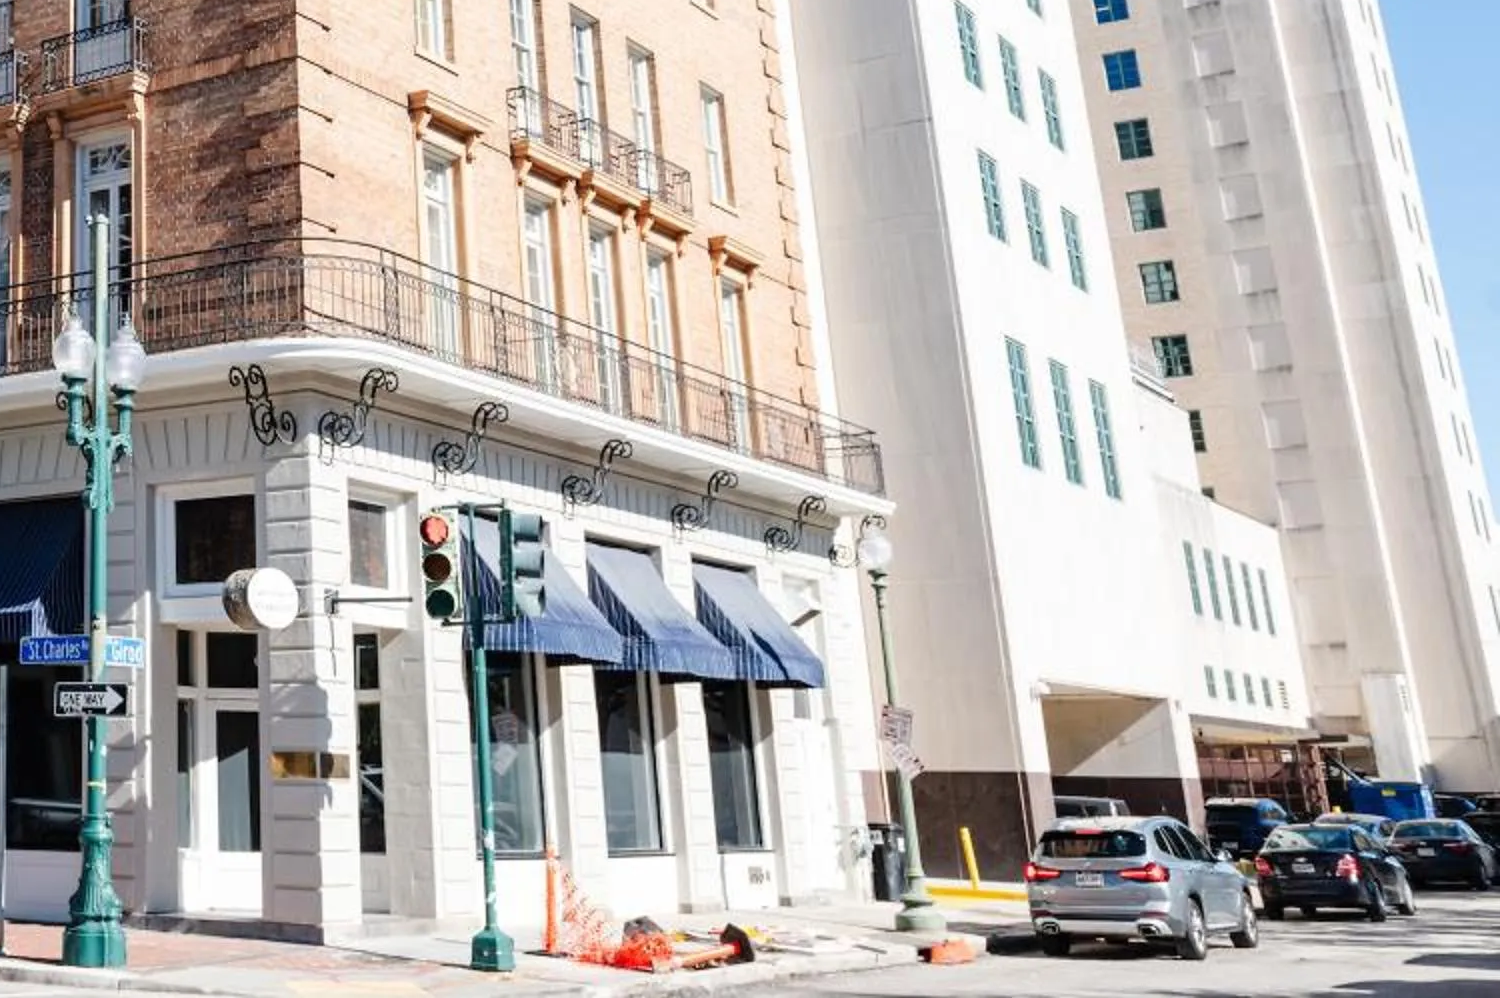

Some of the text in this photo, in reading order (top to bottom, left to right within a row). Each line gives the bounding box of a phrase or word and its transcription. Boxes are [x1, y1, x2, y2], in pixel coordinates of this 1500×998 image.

[43, 639, 81, 659] Charles
[111, 641, 144, 663] Girod
[61, 693, 105, 707] ONE WAY
